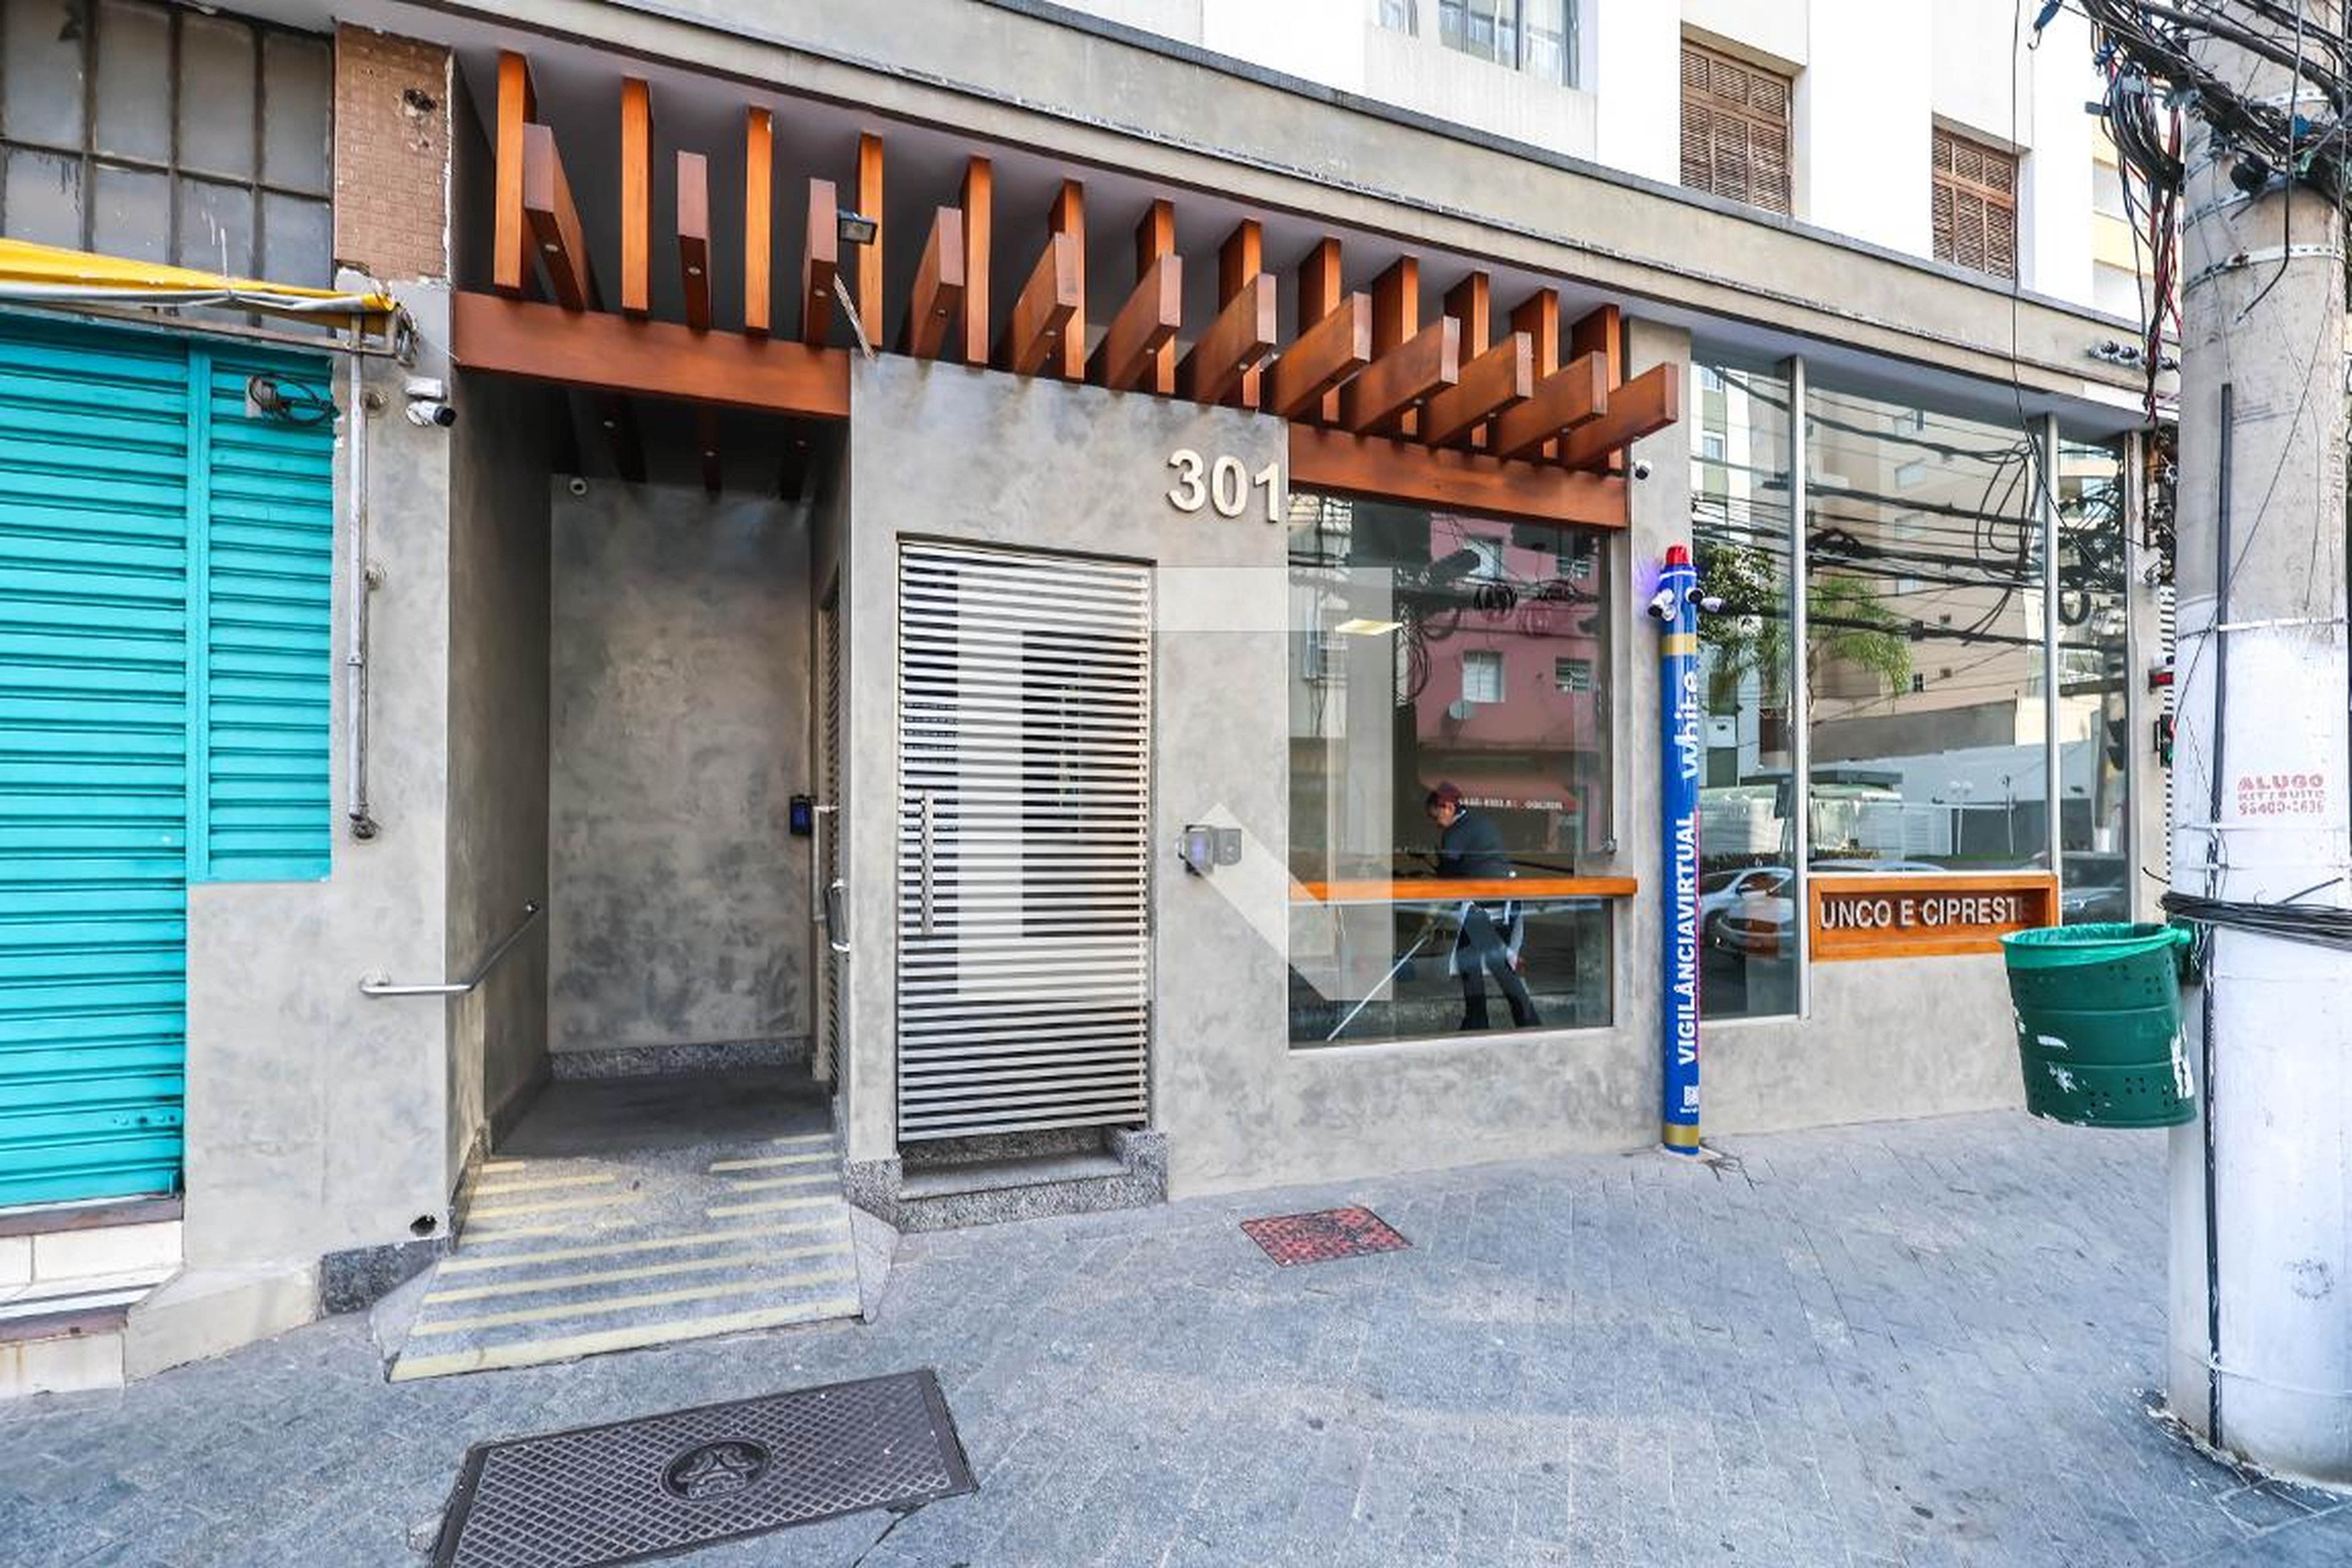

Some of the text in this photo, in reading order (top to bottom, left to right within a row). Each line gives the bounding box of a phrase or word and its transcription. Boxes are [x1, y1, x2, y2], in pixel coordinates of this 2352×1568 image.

[1167, 448, 1280, 523] 301
[1673, 671, 1698, 780] white
[2238, 774, 2323, 791] ALUGO
[1900, 899, 1914, 927] E
[1922, 895, 2022, 926] CIPREST
